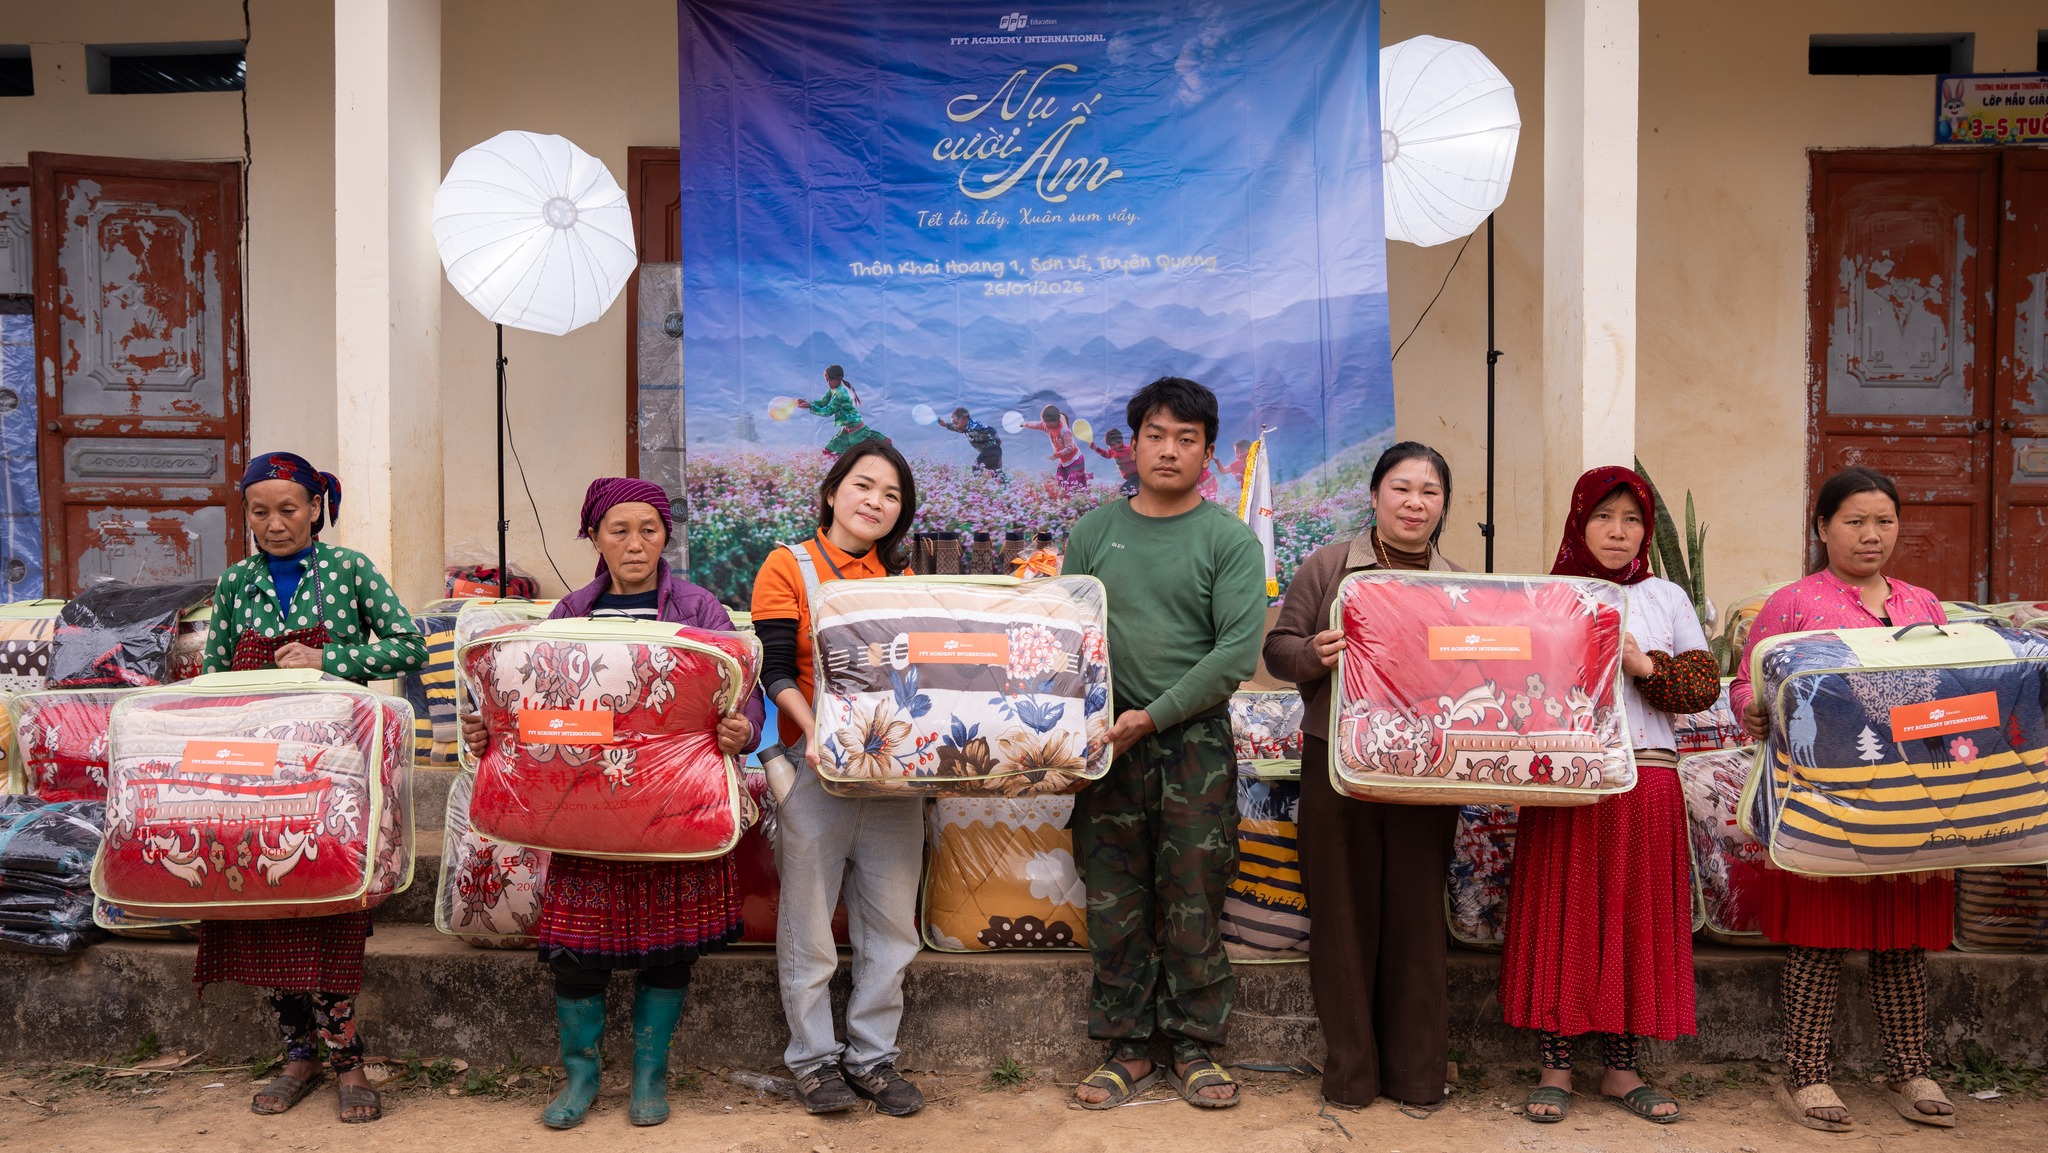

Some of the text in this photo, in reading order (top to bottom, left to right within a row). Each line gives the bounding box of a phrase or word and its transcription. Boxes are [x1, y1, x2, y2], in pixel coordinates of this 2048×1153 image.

[999, 12, 1028, 31] FPT
[950, 34, 1106, 45] FPT ACADEMY INTERNATIONAL
[946, 63, 1078, 127] Nụ
[1983, 94, 2002, 106] LỚP
[932, 126, 1022, 161] cười
[917, 209, 943, 227] Tết
[949, 209, 970, 226] đủ
[1019, 207, 1063, 225] Xuân
[1069, 213, 1101, 223] sum
[849, 260, 893, 276] Thôn
[898, 259, 940, 275] Khai
[945, 260, 1004, 278] Hoang
[1031, 257, 1064, 272] Sơn
[1097, 254, 1151, 277] Tuyên
[1156, 254, 1217, 273] Quang
[983, 279, 1085, 297] 26/01/2026
[1915, 722, 1943, 730] ACADEMY
[1943, 714, 1989, 726] INTERNATIONAL
[140, 788, 157, 799] GA
